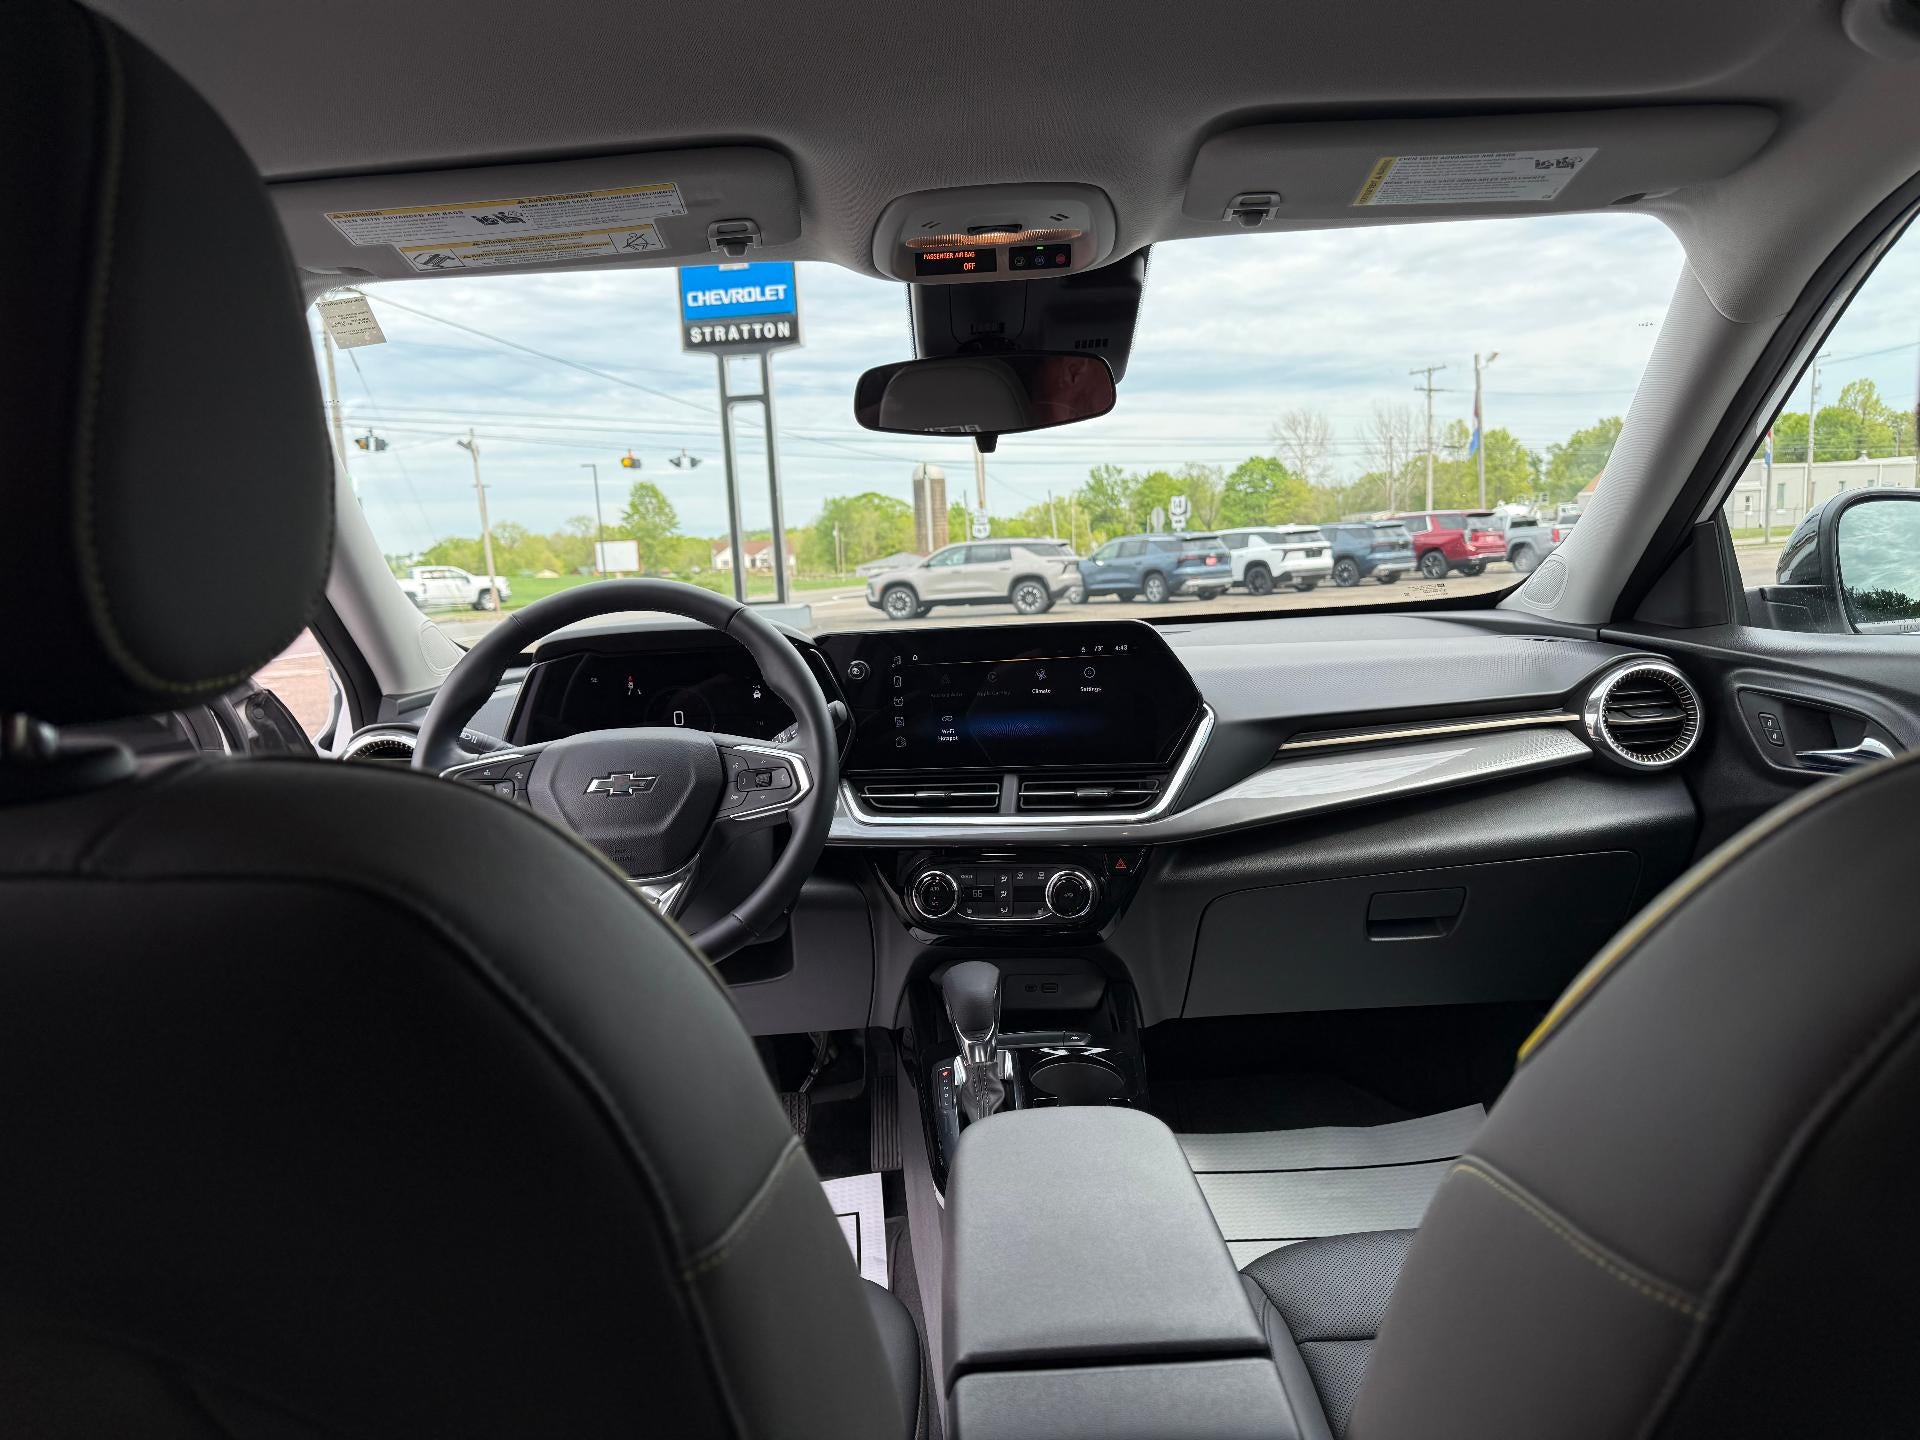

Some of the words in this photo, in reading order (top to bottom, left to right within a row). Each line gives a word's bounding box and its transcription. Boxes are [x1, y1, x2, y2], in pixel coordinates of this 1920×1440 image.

[963, 262, 976, 271] OFF
[686, 284, 787, 307] CHEVROLET
[690, 321, 791, 343] STRATTON
